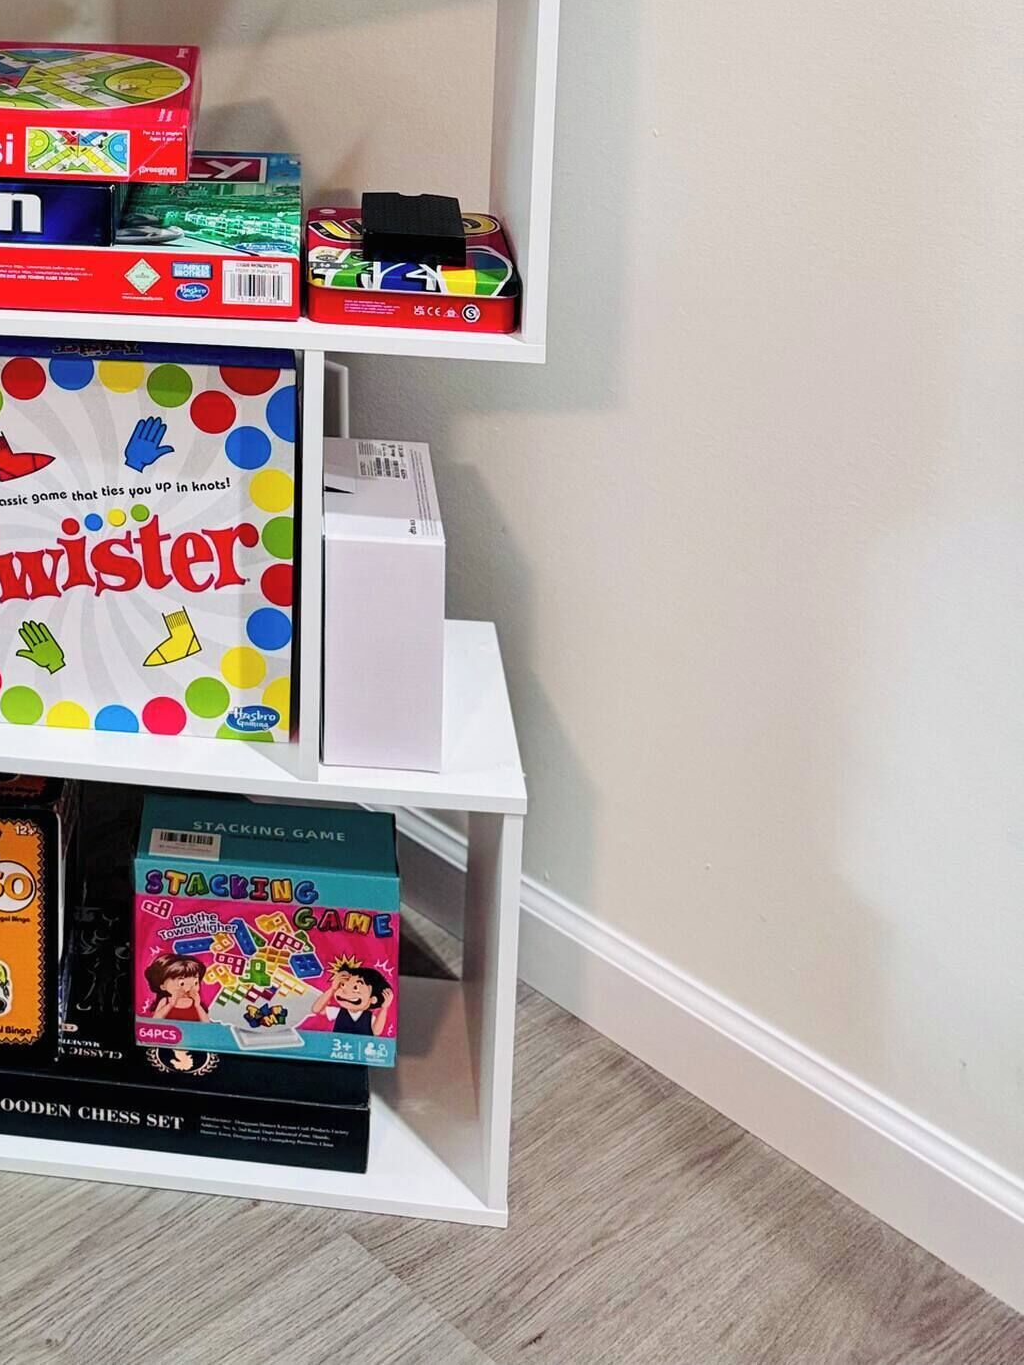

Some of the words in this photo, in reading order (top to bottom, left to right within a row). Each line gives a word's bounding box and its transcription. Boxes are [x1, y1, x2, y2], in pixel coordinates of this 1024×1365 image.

[31, 489, 68, 505] game
[71, 490, 99, 502] that
[101, 485, 125, 497] ties
[128, 485, 152, 499] you
[176, 482, 188, 493] in
[191, 477, 232, 492] knots!
[233, 707, 276, 722] Hasbro
[15, 825, 37, 836] 12+
[192, 820, 286, 837] STACKING
[292, 828, 346, 842] GAME
[144, 868, 320, 905] STACKING
[173, 914, 195, 926] Put
[197, 911, 218, 922] the
[292, 906, 394, 939] GAME
[158, 925, 197, 940] Tower
[198, 921, 238, 934] Higher
[5, 1025, 32, 1036] Bingo
[139, 1027, 177, 1041] 64PCS
[331, 1038, 353, 1051] 3+
[69, 1046, 123, 1060] CLASSIC
[330, 1051, 355, 1061] AGES
[77, 1105, 141, 1126] CHESS
[146, 1113, 185, 1131] SET
